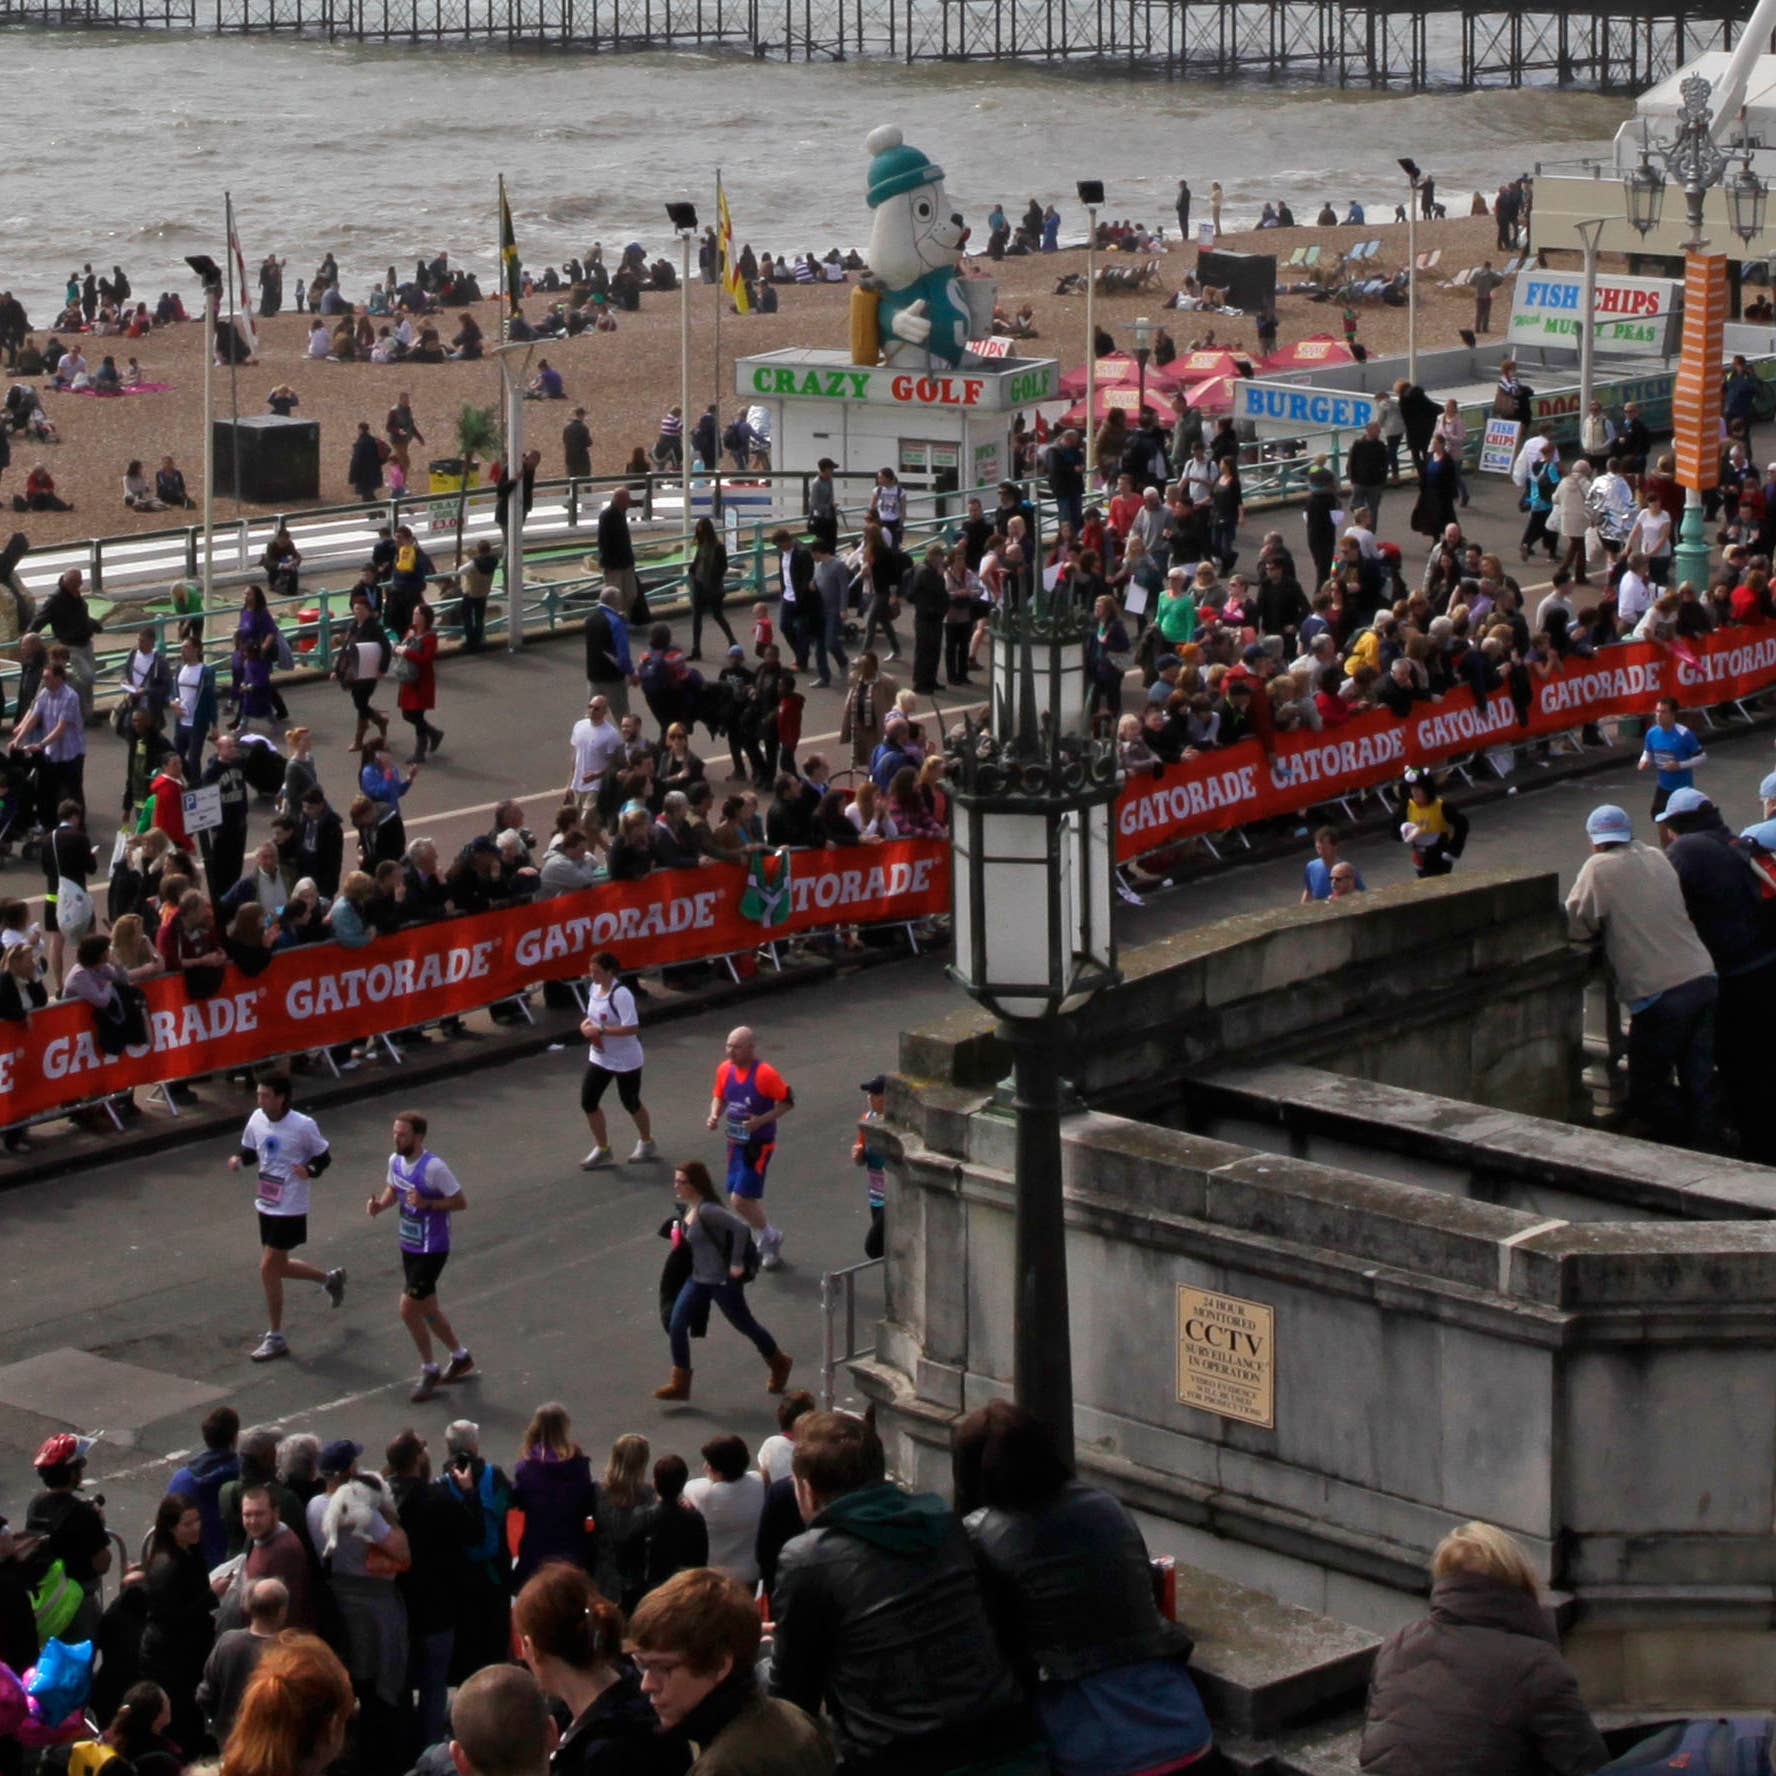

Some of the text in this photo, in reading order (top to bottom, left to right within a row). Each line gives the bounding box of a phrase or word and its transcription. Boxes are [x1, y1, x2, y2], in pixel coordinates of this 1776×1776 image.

[1525, 282, 1660, 316] FISH CHIPS
[1613, 323, 1656, 352] PEAS
[753, 367, 984, 406] CRAZY GOLF
[1010, 368, 1051, 404] GOLF
[1246, 387, 1372, 427] BURGER
[1487, 434, 1514, 446] CHIPS
[1492, 422, 1515, 435] FISH
[1120, 766, 1257, 835] GATORADE
[1541, 662, 1662, 714] GATORADE
[285, 942, 494, 1020] GATORADE
[515, 891, 717, 966] GATORADE
[788, 858, 933, 912] TORADE
[1192, 1306, 1256, 1330] MONITORED
[1203, 1297, 1245, 1316] 24 HOUR
[1185, 1318, 1263, 1357] CCTV
[1185, 1343, 1266, 1372] SURVEILLANCE
[1188, 1355, 1260, 1383] IN OPERATION
